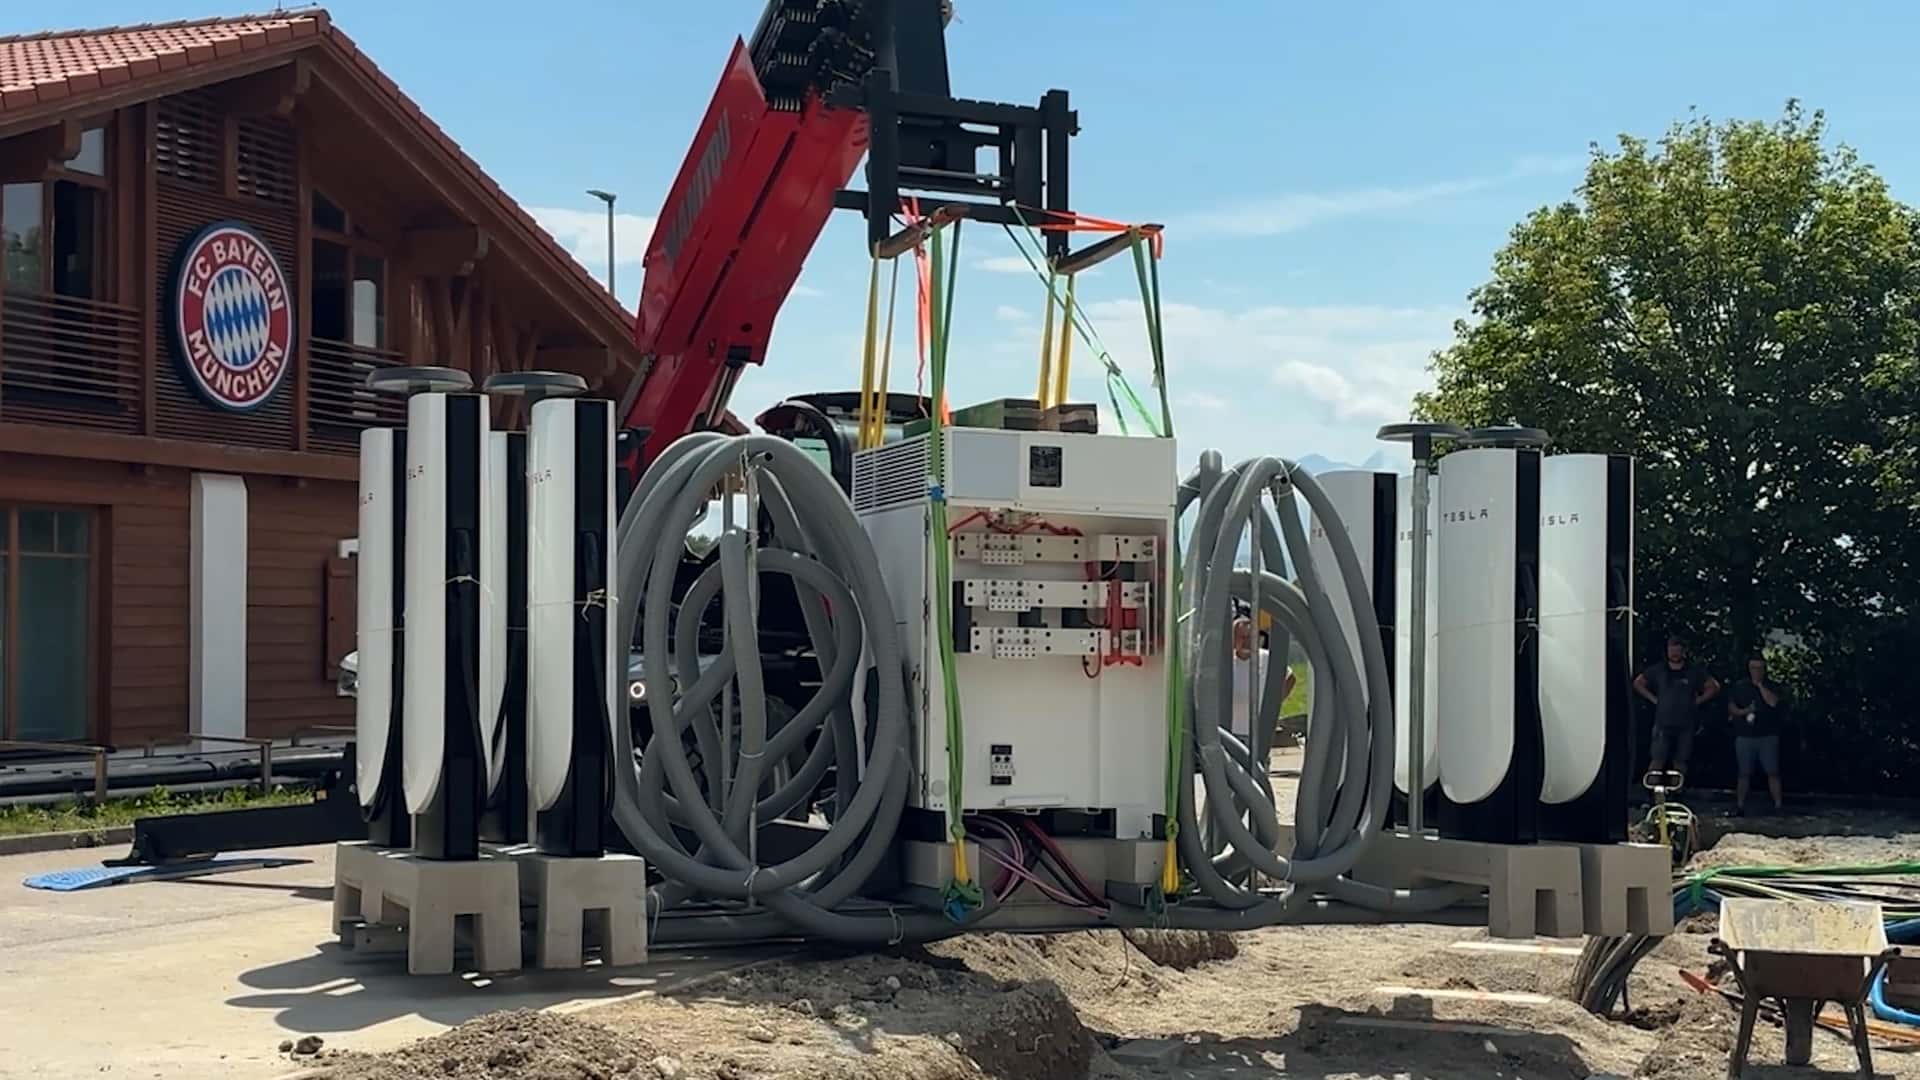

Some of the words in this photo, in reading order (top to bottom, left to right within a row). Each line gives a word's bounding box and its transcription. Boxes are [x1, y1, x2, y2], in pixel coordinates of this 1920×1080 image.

[188, 255, 211, 297] FC
[212, 238, 284, 312] BAYERN
[188, 329, 284, 398] MÜNCHEN
